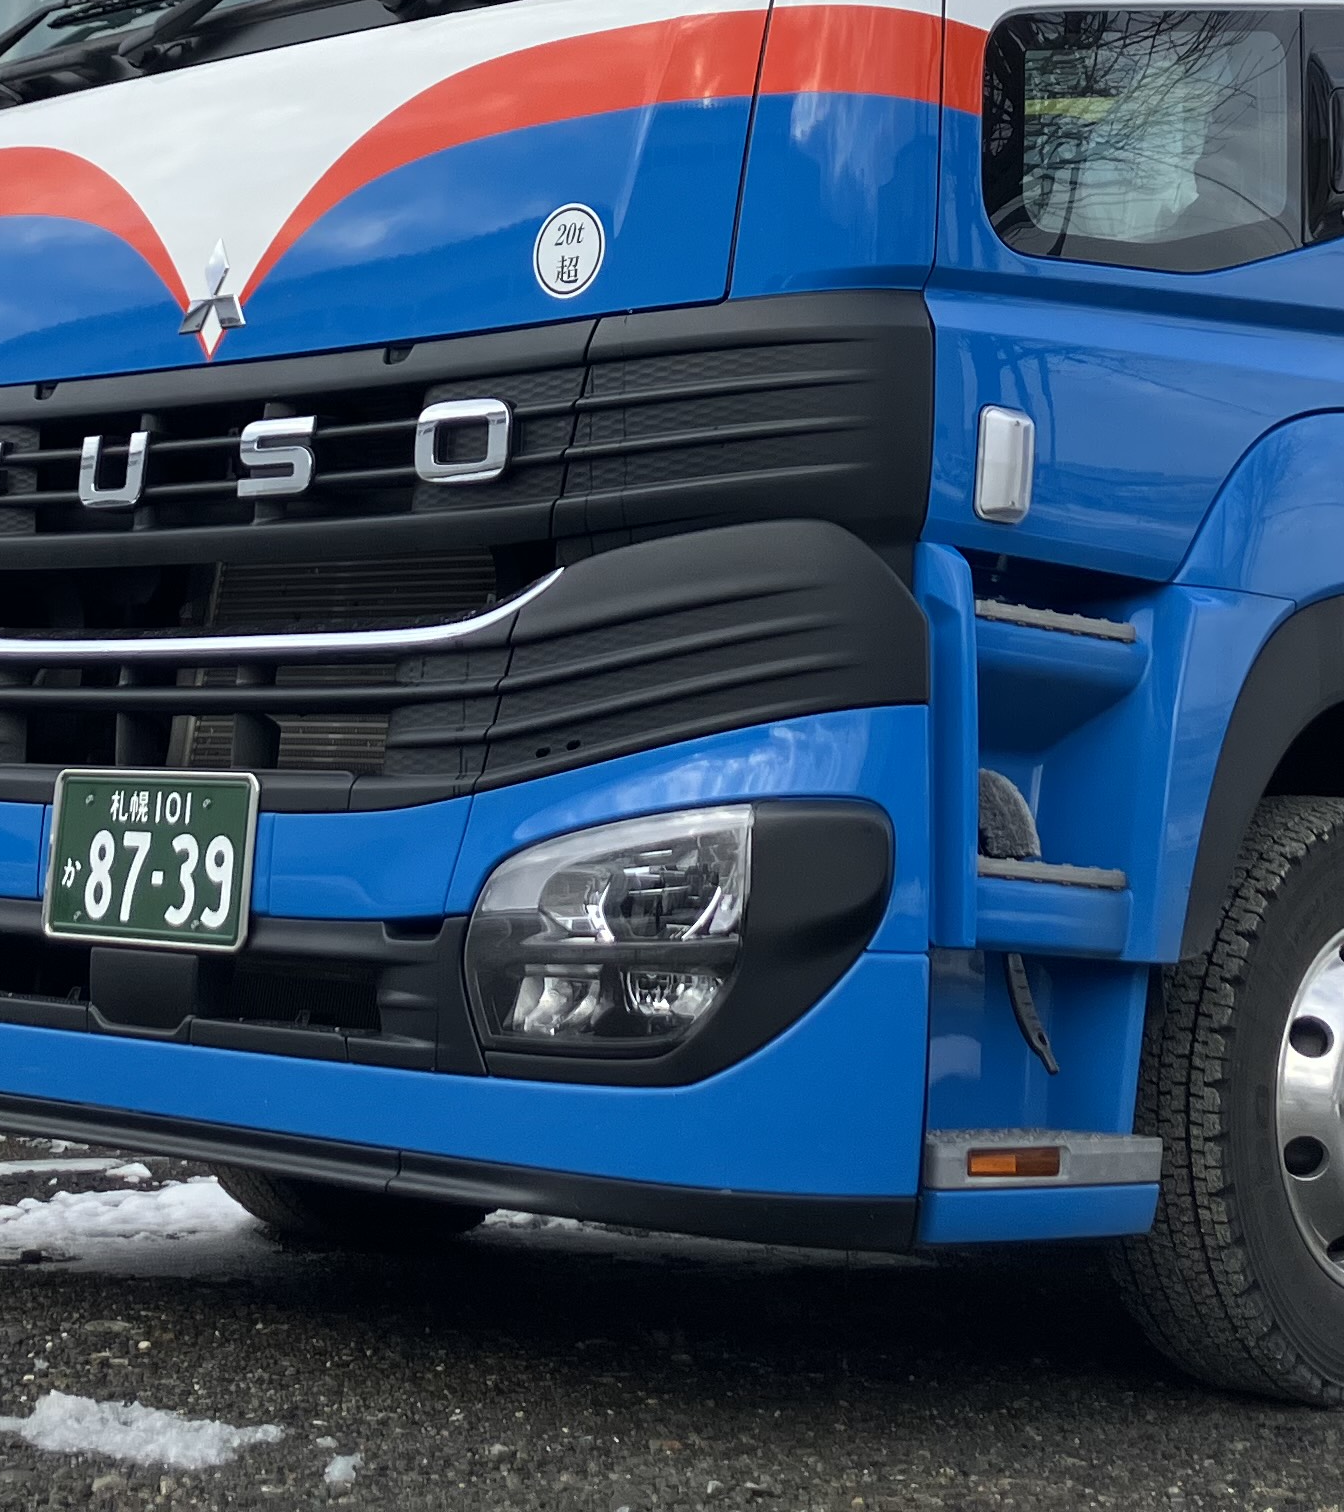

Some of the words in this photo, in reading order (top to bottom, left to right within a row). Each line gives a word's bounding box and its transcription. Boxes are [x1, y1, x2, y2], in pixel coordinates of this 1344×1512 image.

[554, 221, 585, 247] 20t
[554, 254, 580, 284] 超
[61, 857, 82, 889] か
